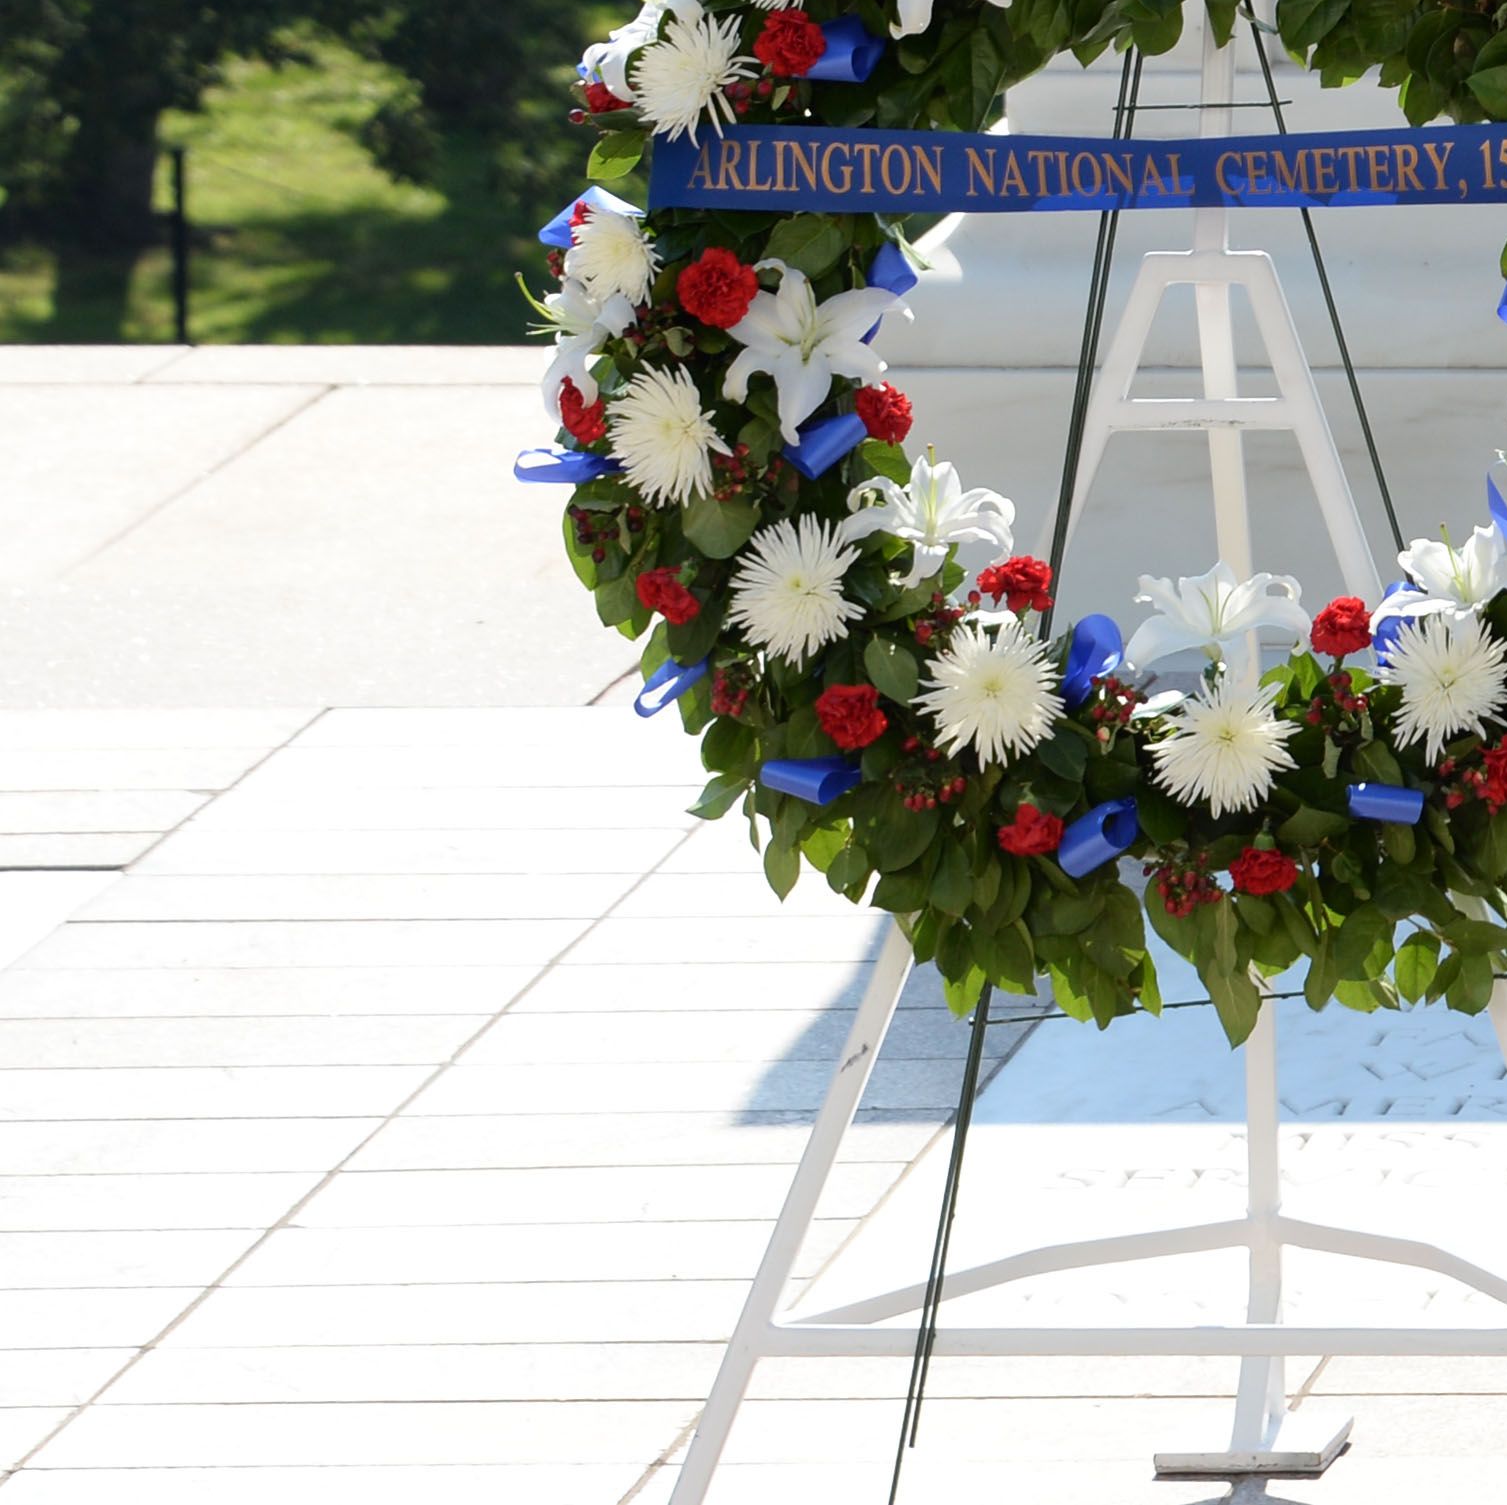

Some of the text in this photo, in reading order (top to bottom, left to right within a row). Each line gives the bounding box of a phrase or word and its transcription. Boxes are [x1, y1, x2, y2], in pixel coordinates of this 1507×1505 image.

[686, 138, 943, 195] ARLINGTON
[965, 146, 1197, 198] NATIONAL
[1213, 140, 1469, 198] CEMETERY,
